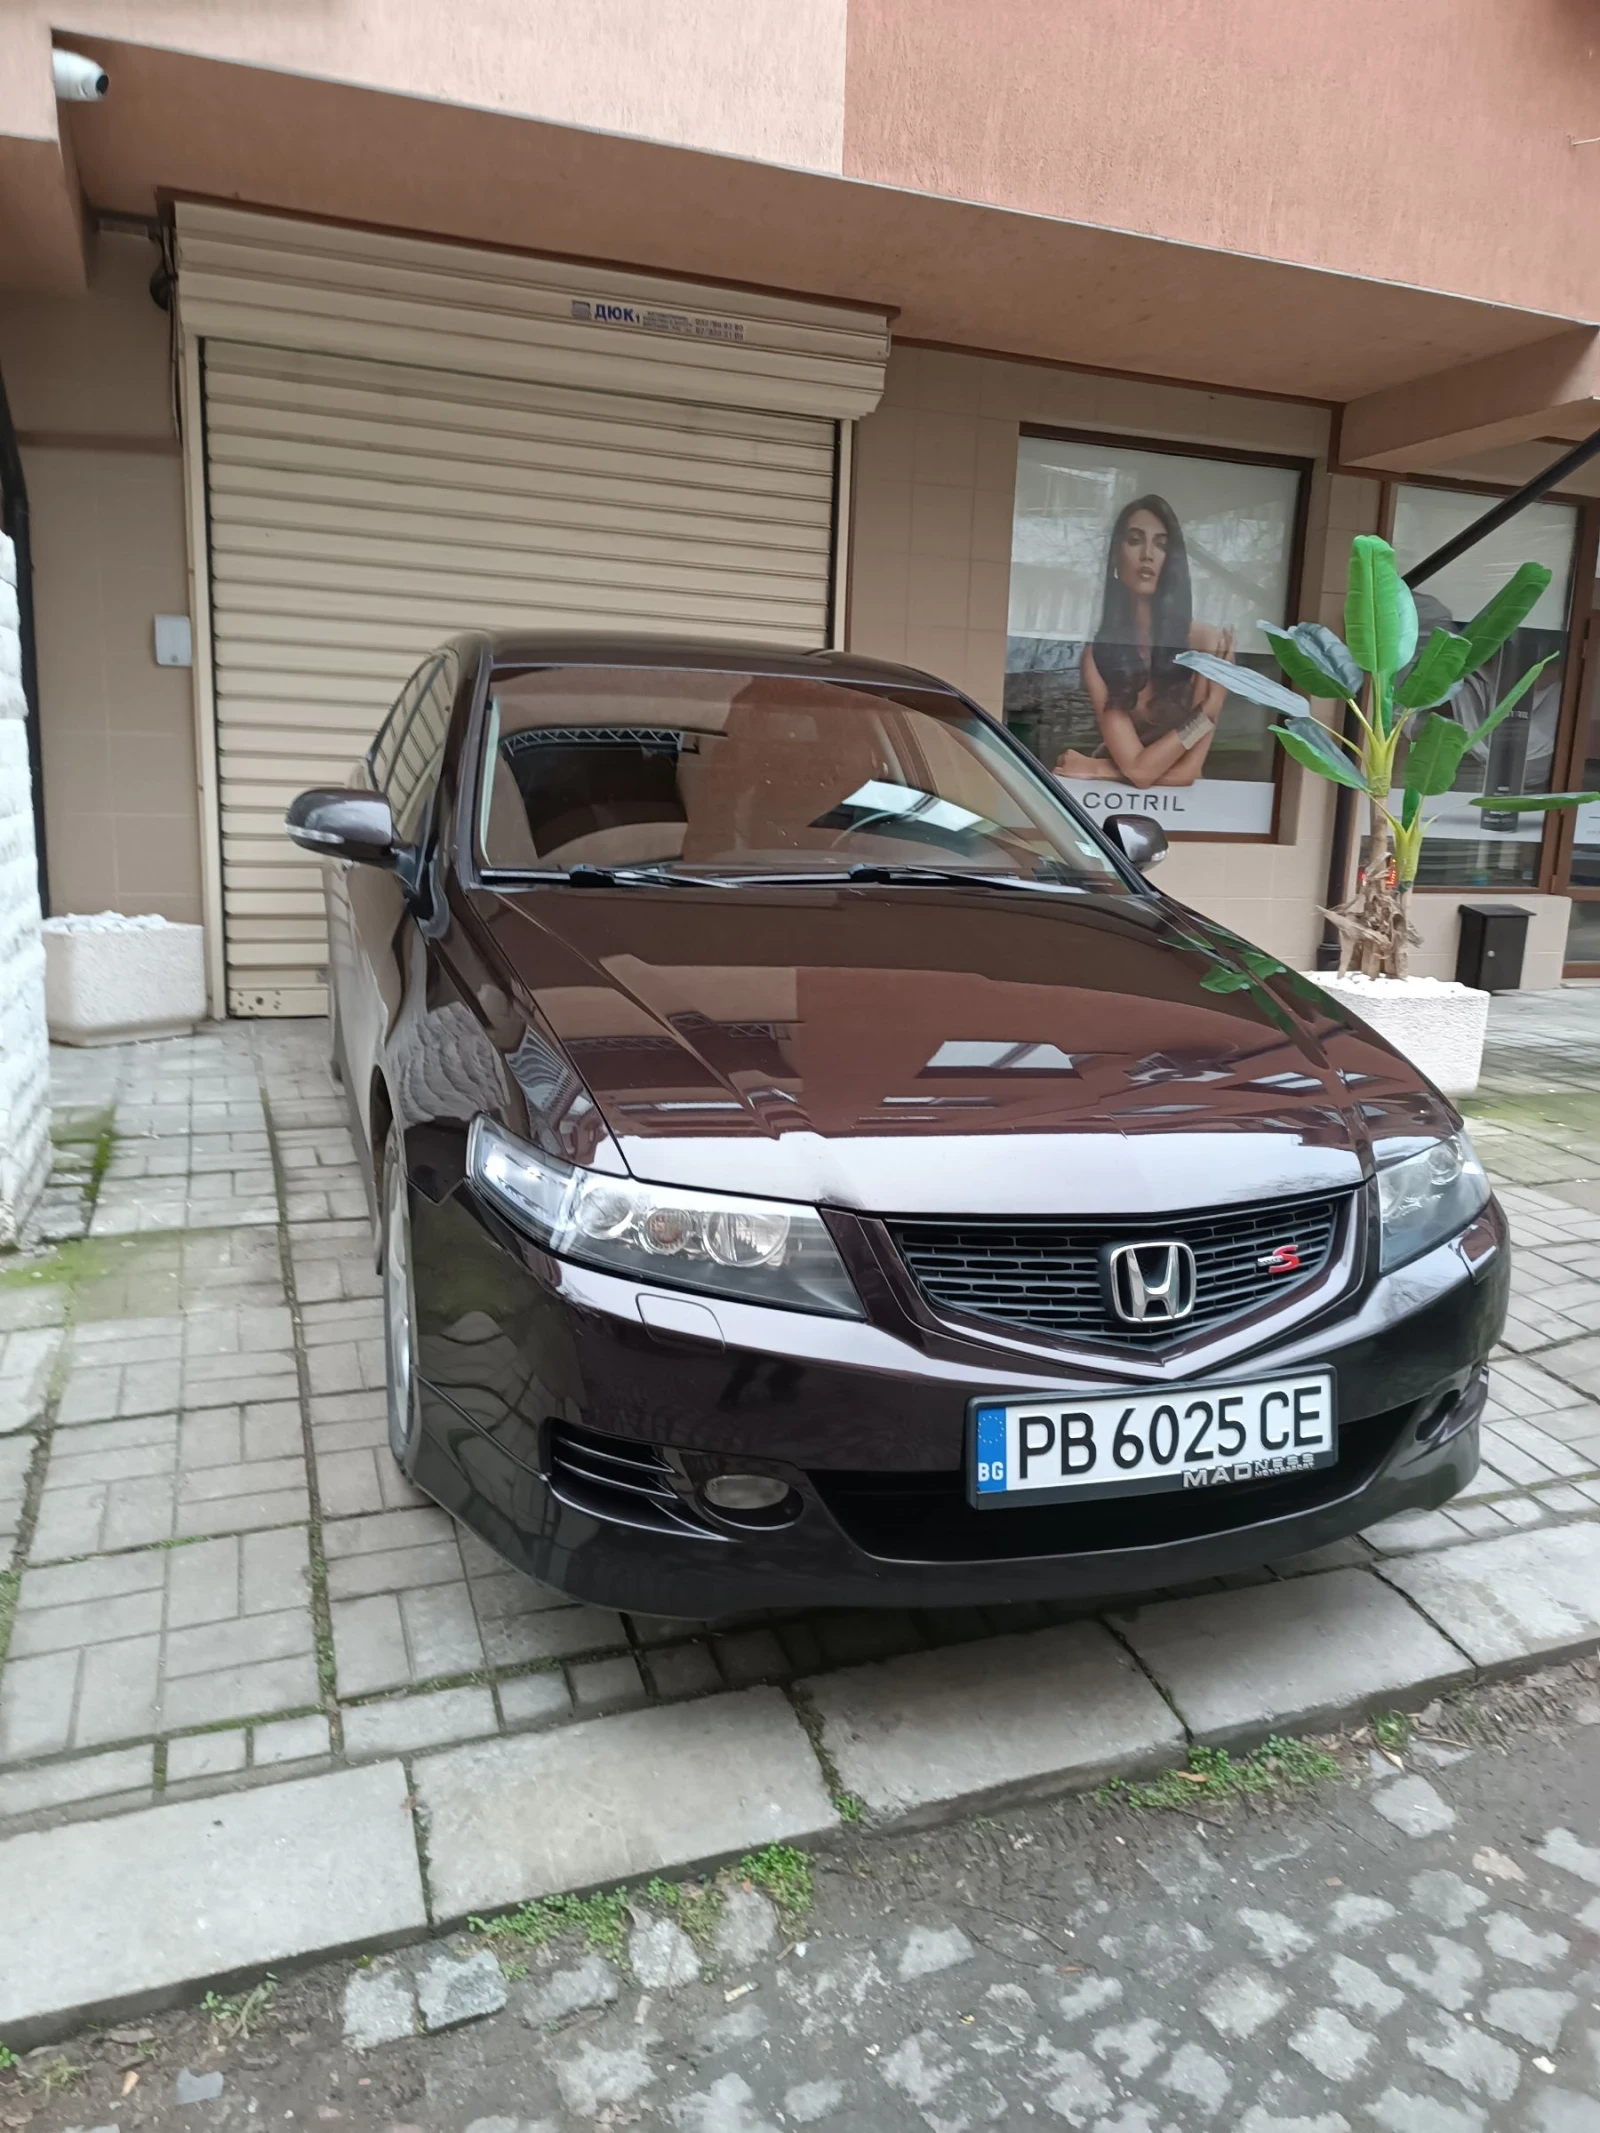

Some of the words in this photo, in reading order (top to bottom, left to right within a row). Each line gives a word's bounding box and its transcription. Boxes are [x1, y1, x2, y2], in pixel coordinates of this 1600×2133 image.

[594, 303, 634, 322] ДЮК
[1082, 791, 1186, 812] COTRIL
[1018, 1412, 1097, 1479] PB
[1112, 1396, 1247, 1470] 6025
[1259, 1385, 1324, 1451] CE
[978, 1461, 1004, 1482] BG
